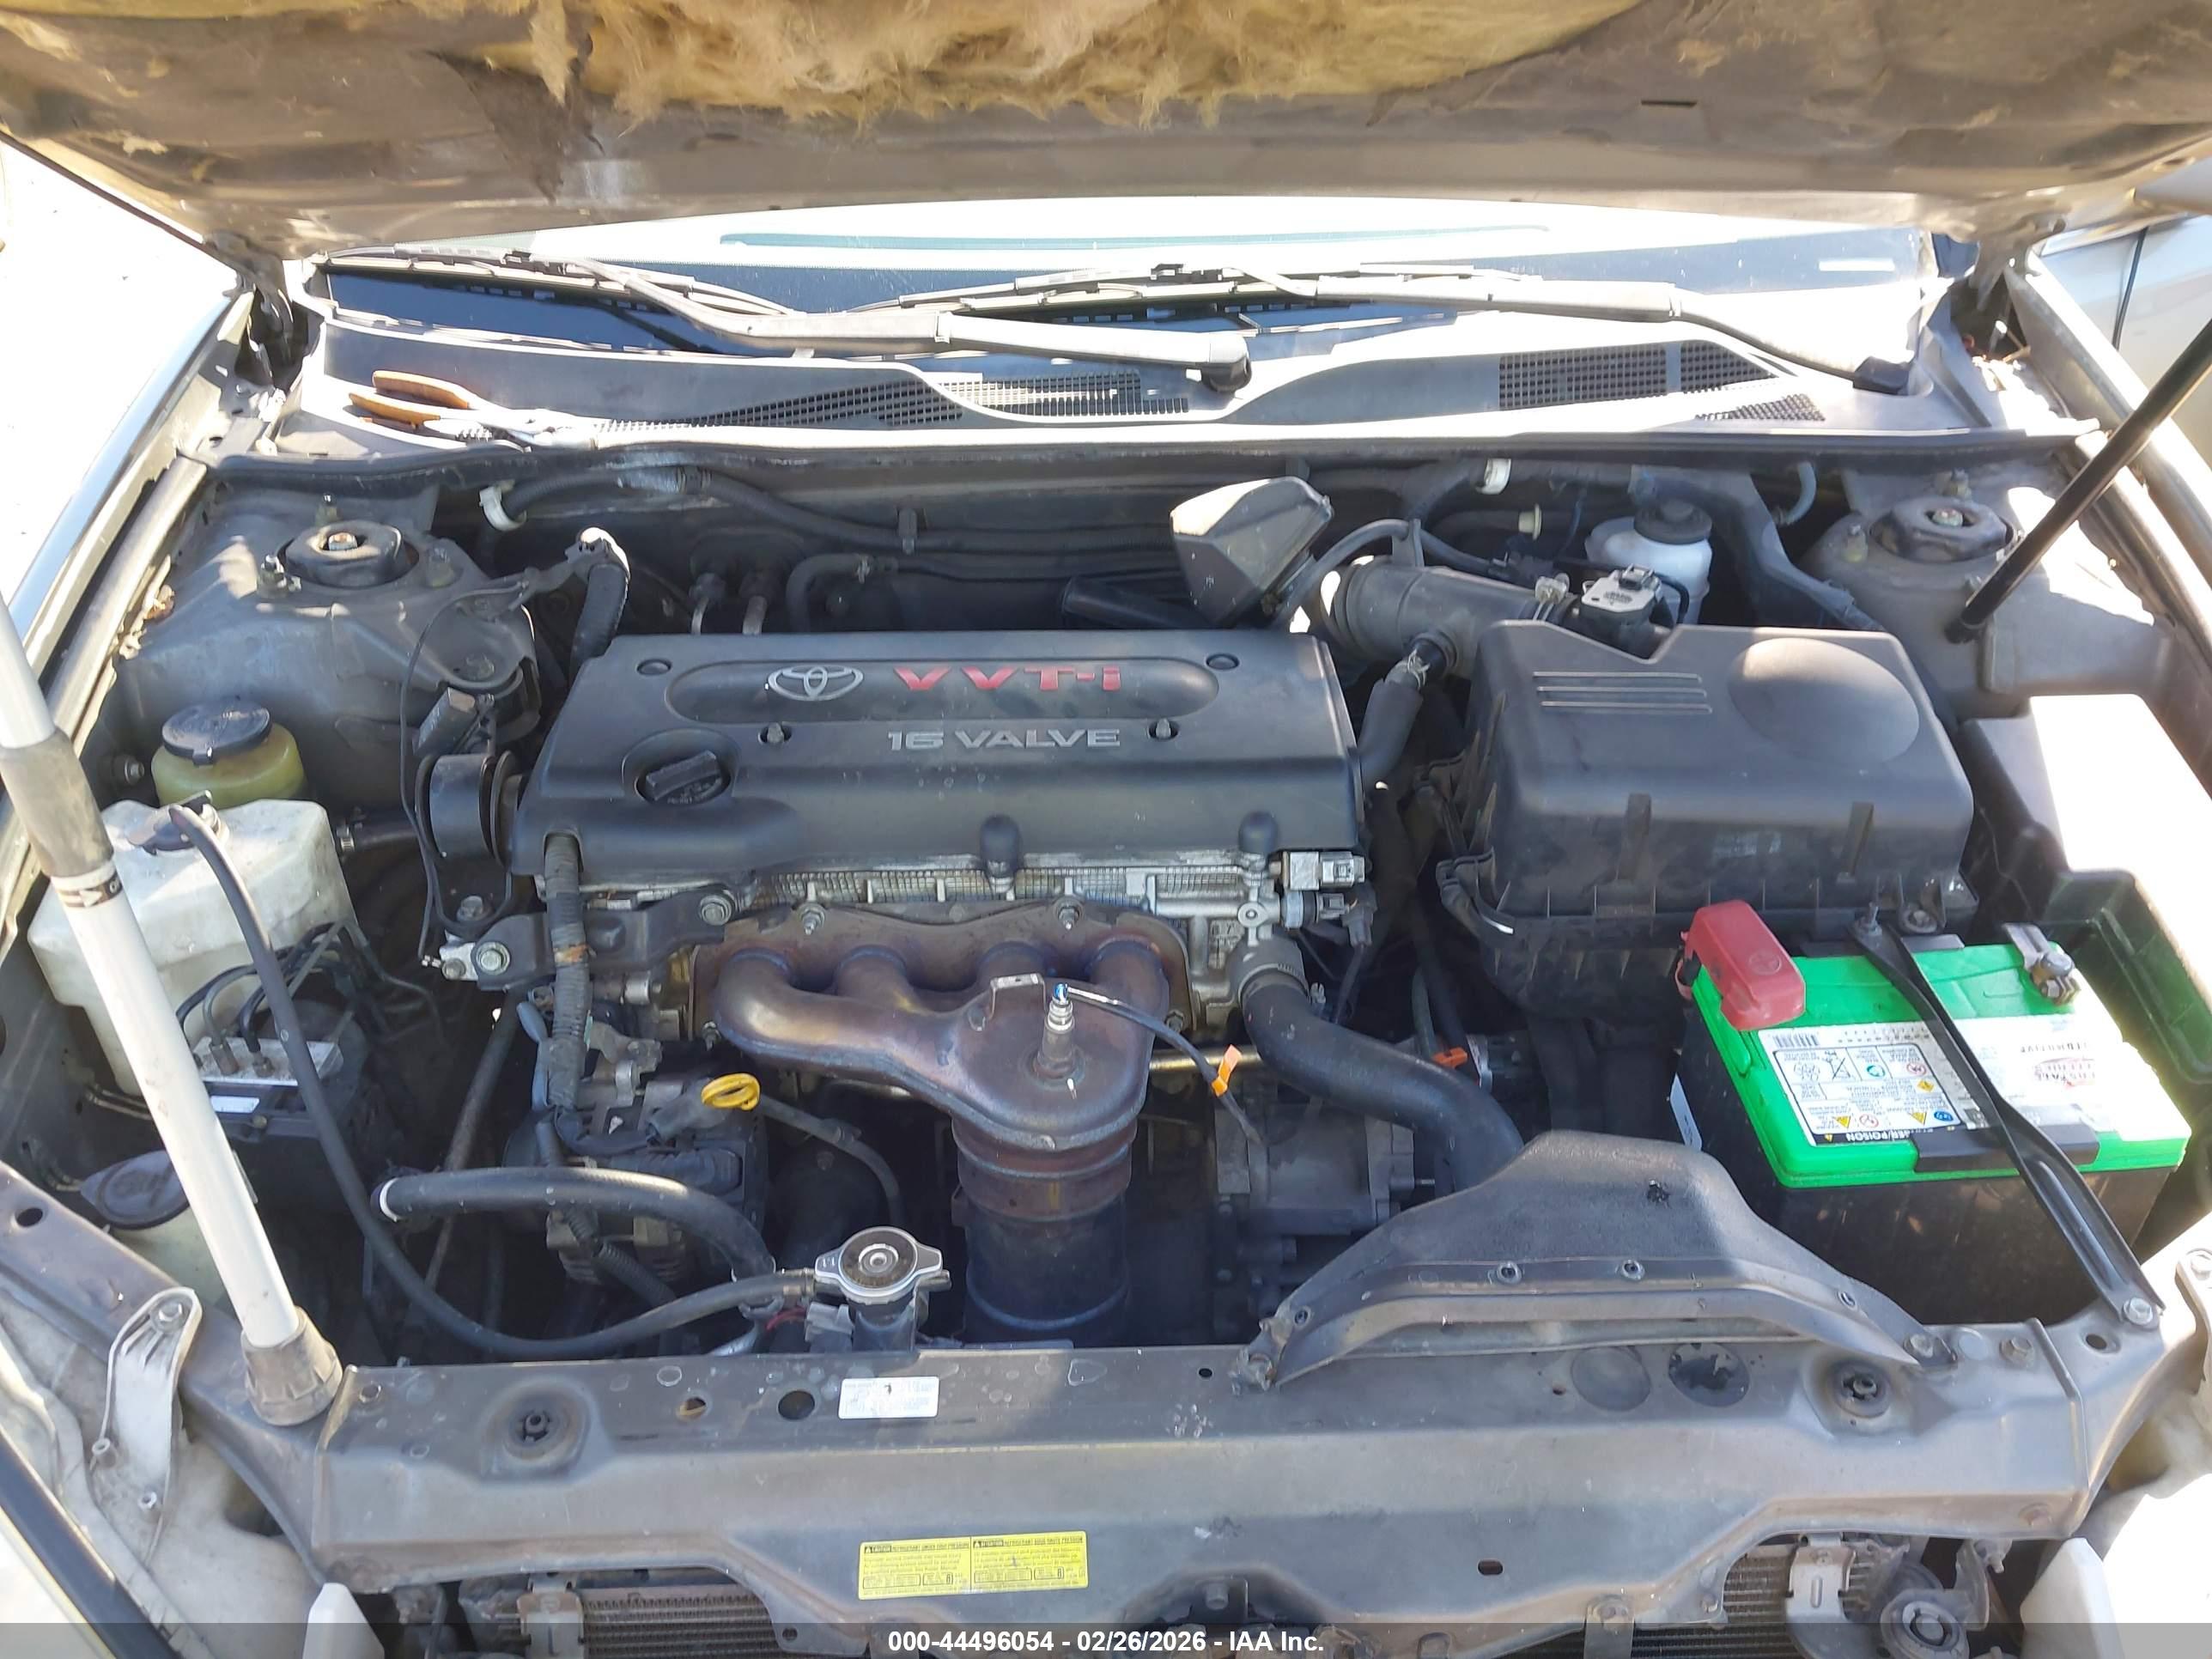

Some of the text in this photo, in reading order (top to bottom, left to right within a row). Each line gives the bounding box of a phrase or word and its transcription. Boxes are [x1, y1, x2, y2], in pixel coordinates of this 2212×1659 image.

[894, 666, 1121, 691] VVT-i
[888, 728, 1120, 750] 16 VALVE
